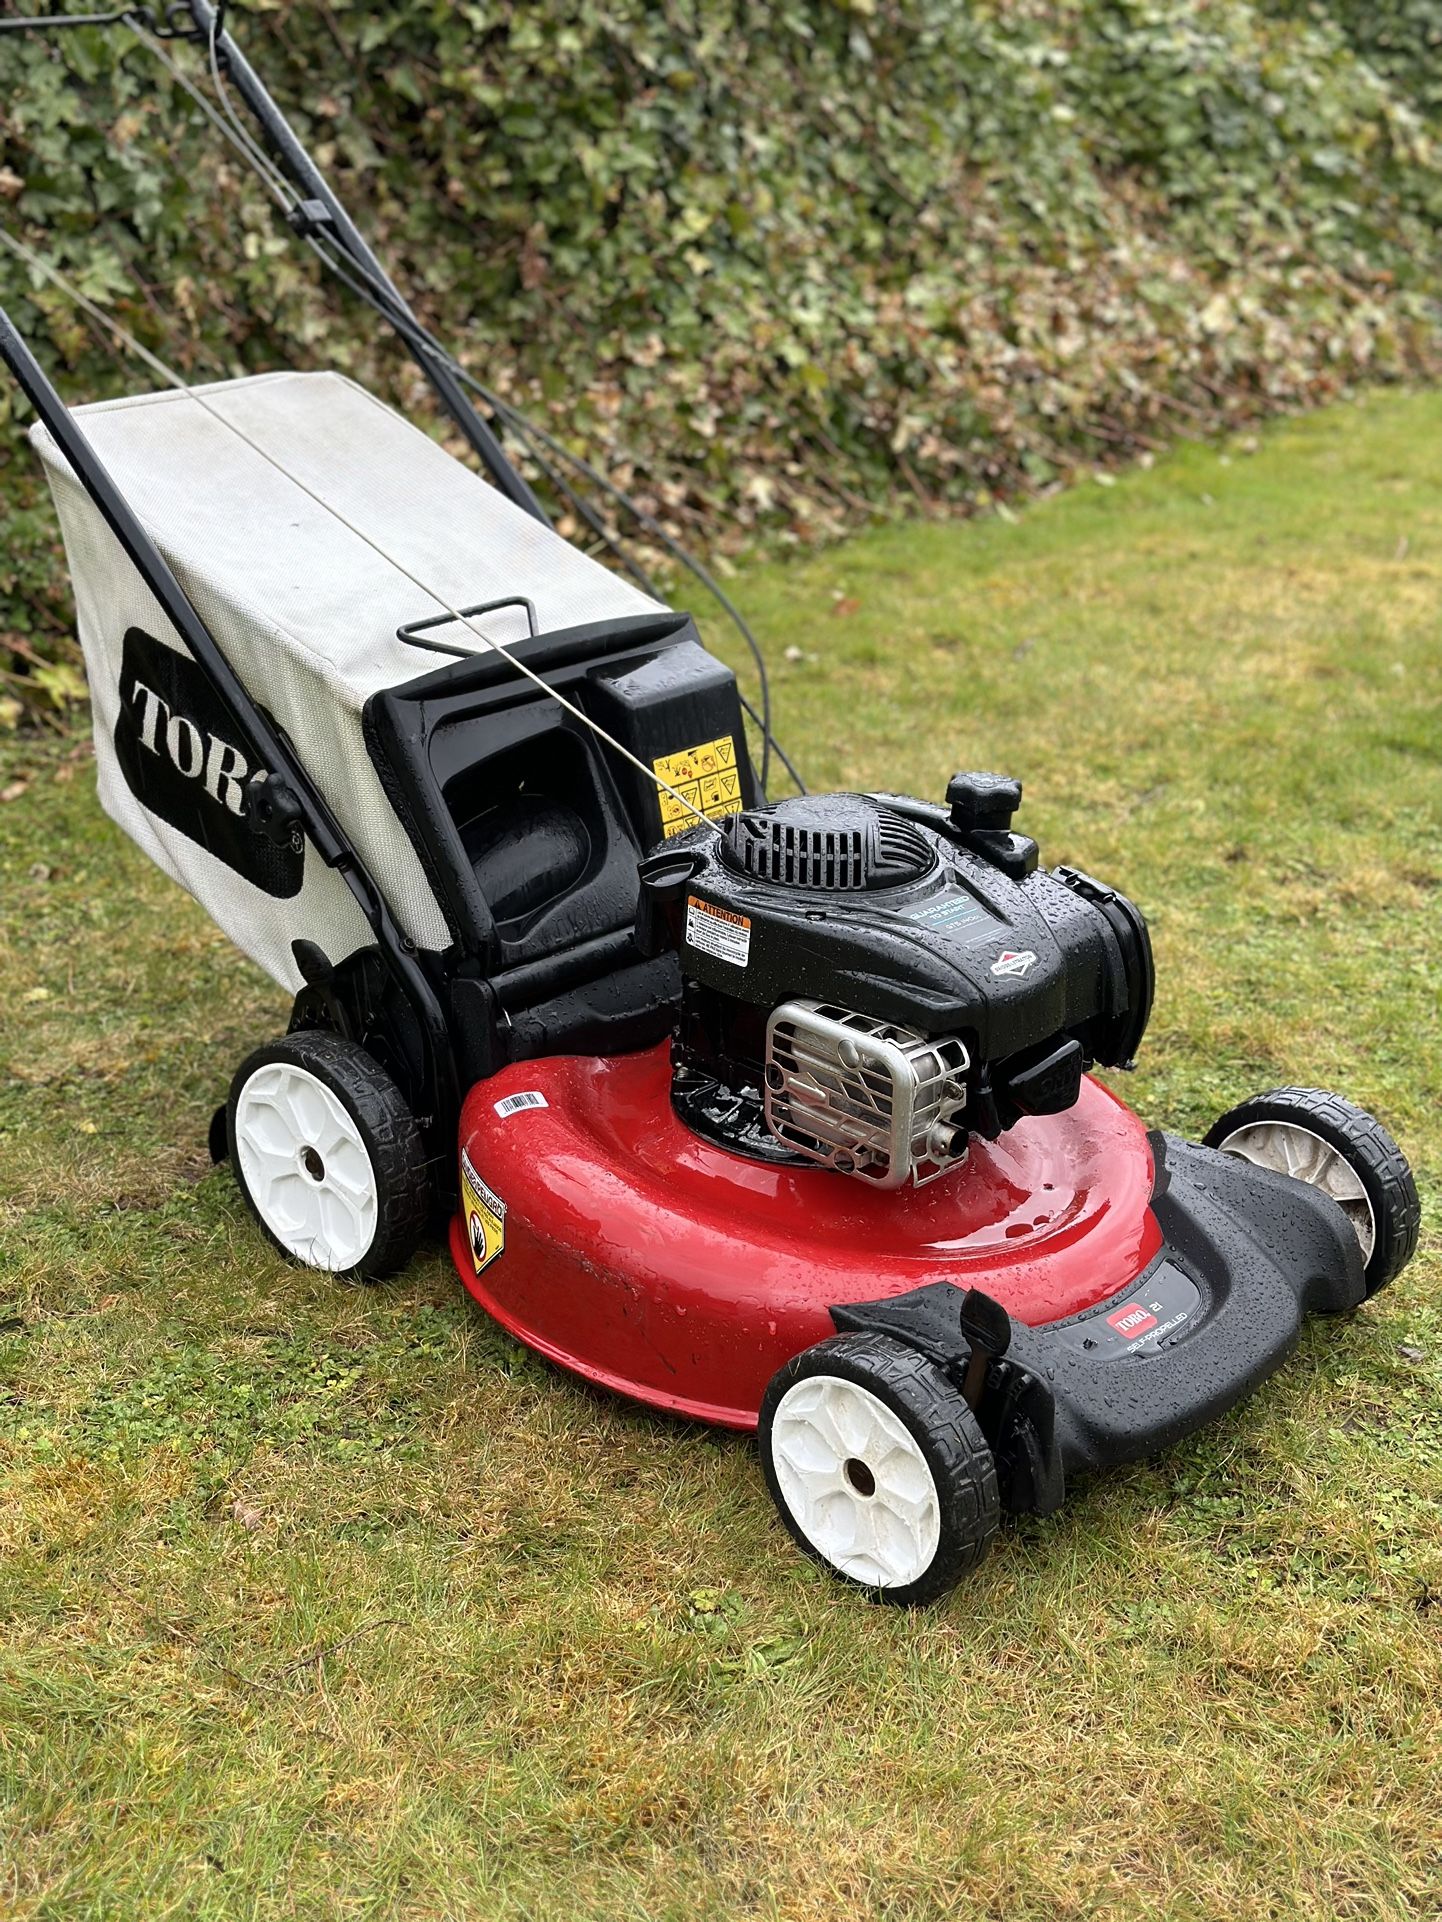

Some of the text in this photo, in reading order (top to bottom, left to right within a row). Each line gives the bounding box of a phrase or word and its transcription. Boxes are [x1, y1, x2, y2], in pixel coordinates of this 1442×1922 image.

[132, 680, 269, 817] TOR
[703, 903, 744, 926] ATTENTION
[909, 895, 970, 920] GUARANTEED
[940, 905, 966, 917] START
[1115, 1309, 1148, 1332] TORO
[1127, 1312, 1188, 1354] SELF-PROPELLED
